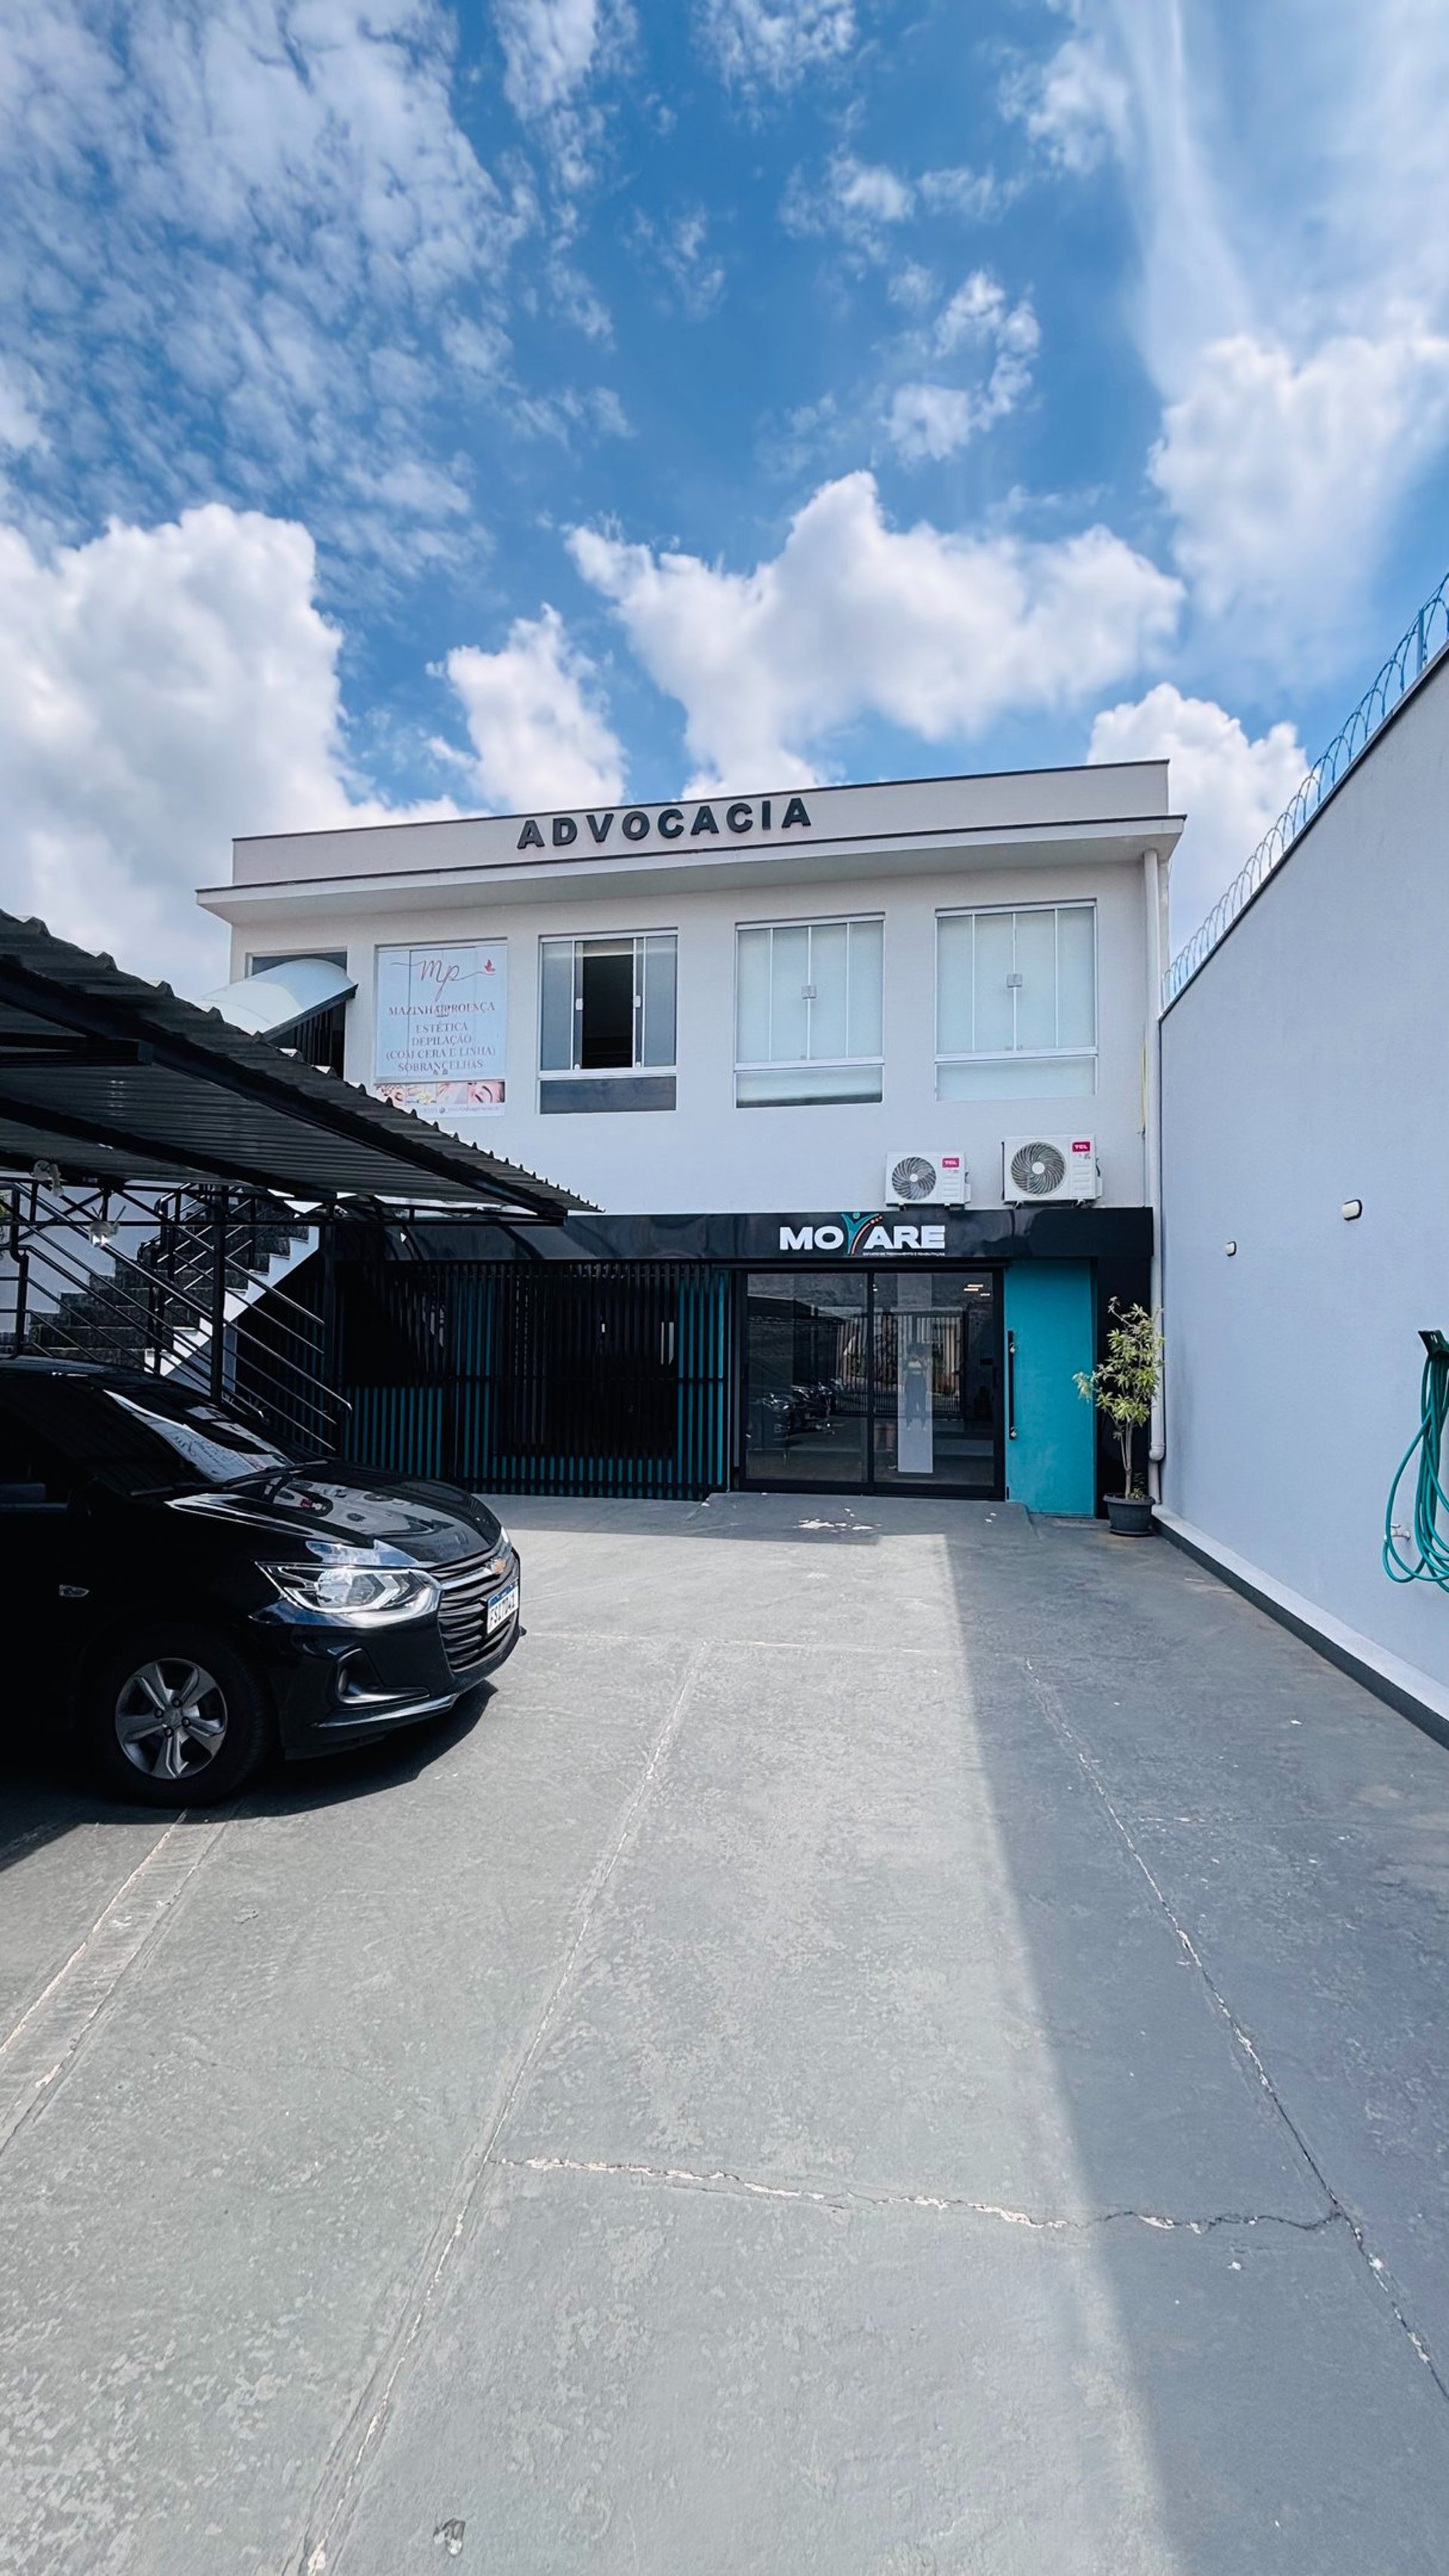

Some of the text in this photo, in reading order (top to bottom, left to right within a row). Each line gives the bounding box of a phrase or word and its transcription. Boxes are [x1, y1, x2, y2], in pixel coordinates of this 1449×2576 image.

[517, 797, 811, 850] ADVOCACIA
[416, 1021, 468, 1033] ESTÉTICA
[411, 1035, 472, 1047] DEPILAÇÃO
[386, 1045, 496, 1060] (COM CERA E LINHA)
[398, 1060, 484, 1073] SOBRANCELHAS
